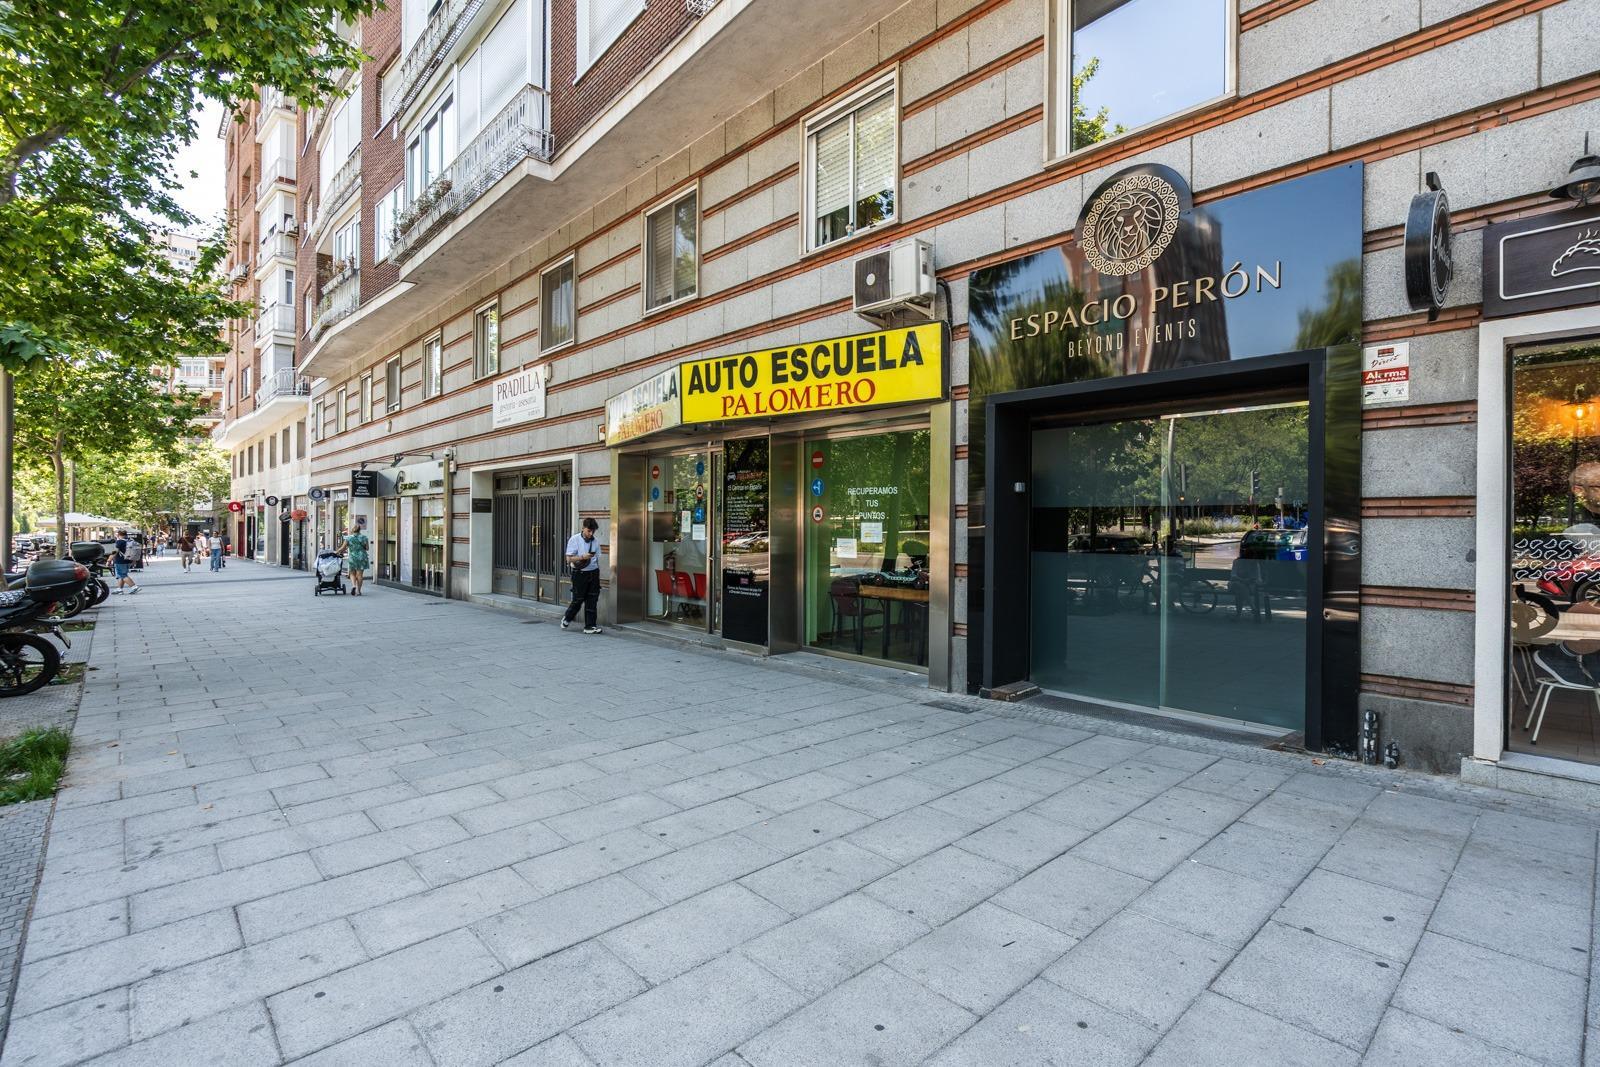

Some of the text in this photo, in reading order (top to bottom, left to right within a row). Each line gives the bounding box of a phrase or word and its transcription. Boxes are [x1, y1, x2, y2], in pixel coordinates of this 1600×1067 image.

[1011, 260, 1282, 341] ESPACIO PERÓN
[1068, 318, 1197, 358] BEYOND EVENTS
[688, 330, 924, 396] AUTO ESCUELA
[497, 371, 541, 402] PRADILLA
[721, 378, 876, 417] PALOMERO
[847, 486, 898, 496] RECUPERAMOS
[865, 499, 879, 507] TUS
[858, 511, 886, 520] PUNTOS
